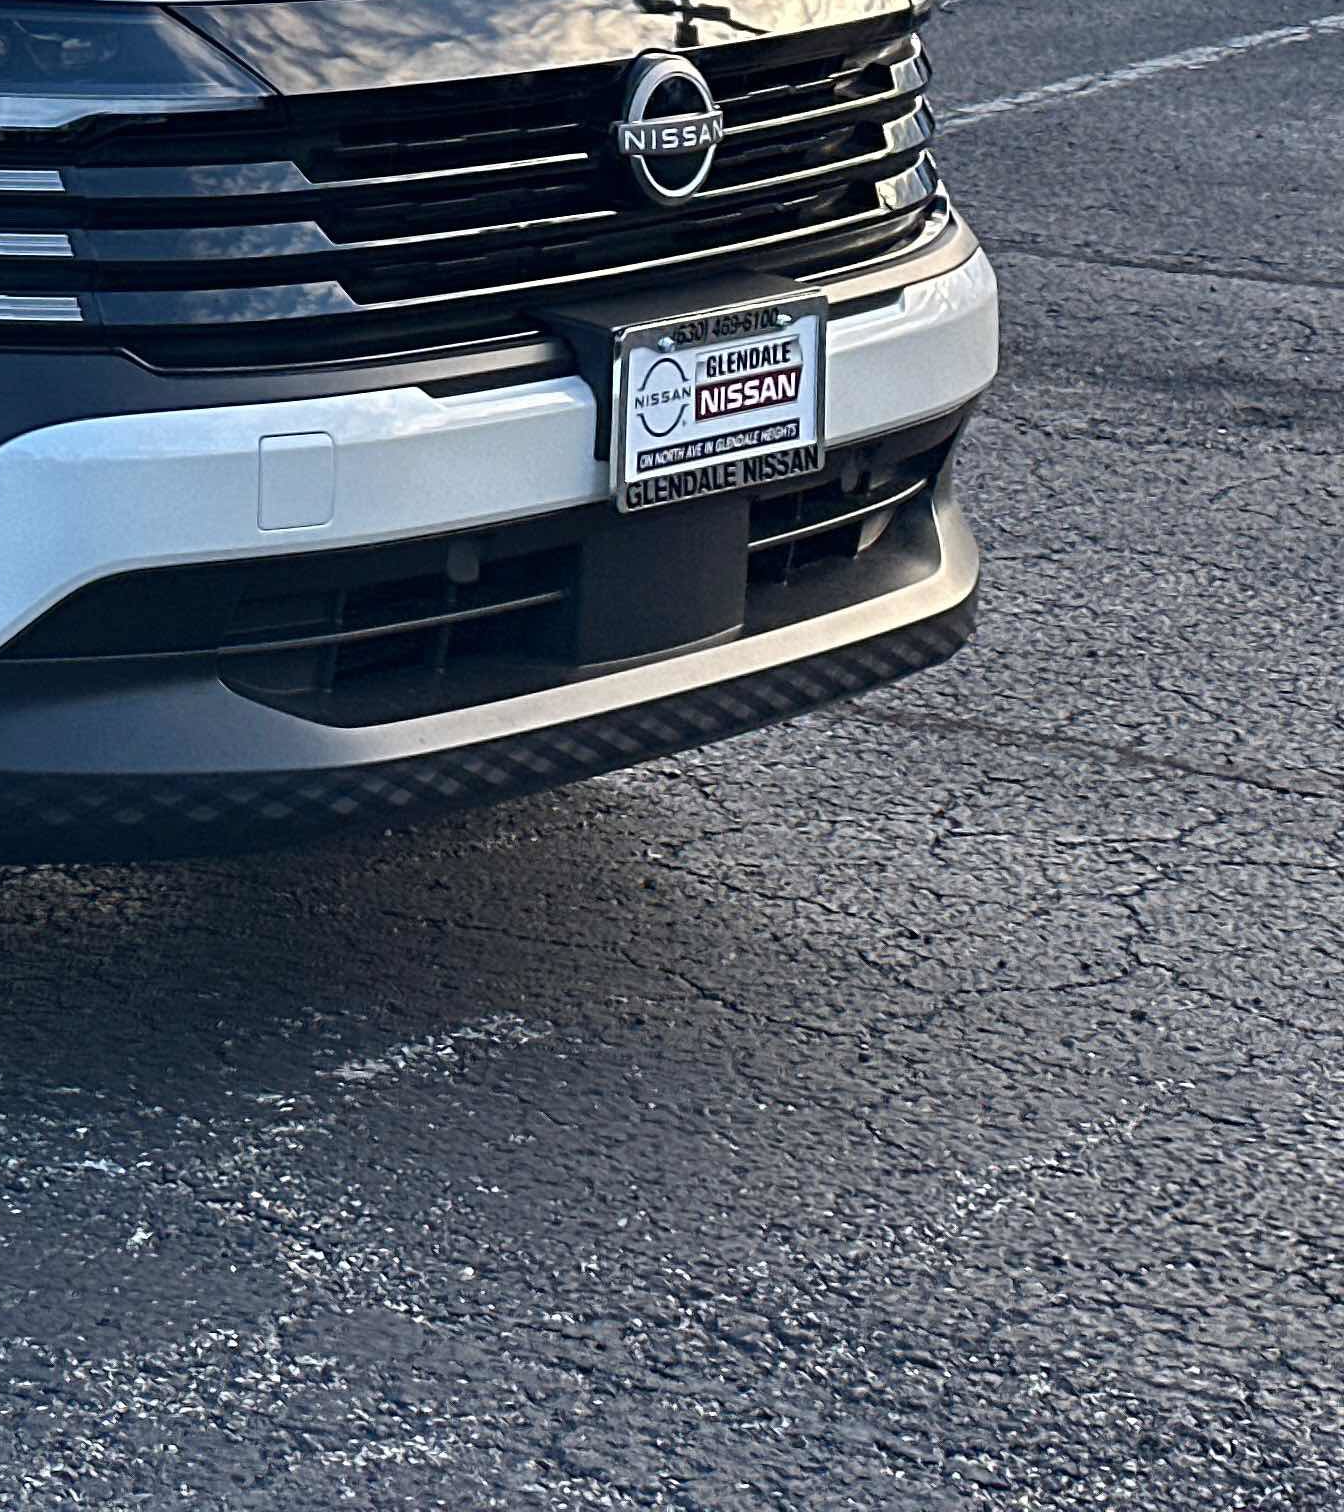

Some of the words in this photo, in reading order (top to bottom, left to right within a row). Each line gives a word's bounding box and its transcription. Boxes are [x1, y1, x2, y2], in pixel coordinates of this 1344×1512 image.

[624, 119, 723, 151] NISSAN
[706, 341, 792, 378] GLENDALE
[634, 385, 692, 409] NISSAN
[700, 372, 796, 416] NISSAN
[639, 454, 654, 468] ON
[655, 447, 685, 467] NORTH
[686, 444, 702, 459] AVE
[704, 442, 714, 455] IN
[715, 431, 760, 451] GLENDALE
[761, 423, 797, 442] HEIGHTS
[625, 464, 738, 509] GLENDALE
[742, 444, 820, 484] NISSAN
